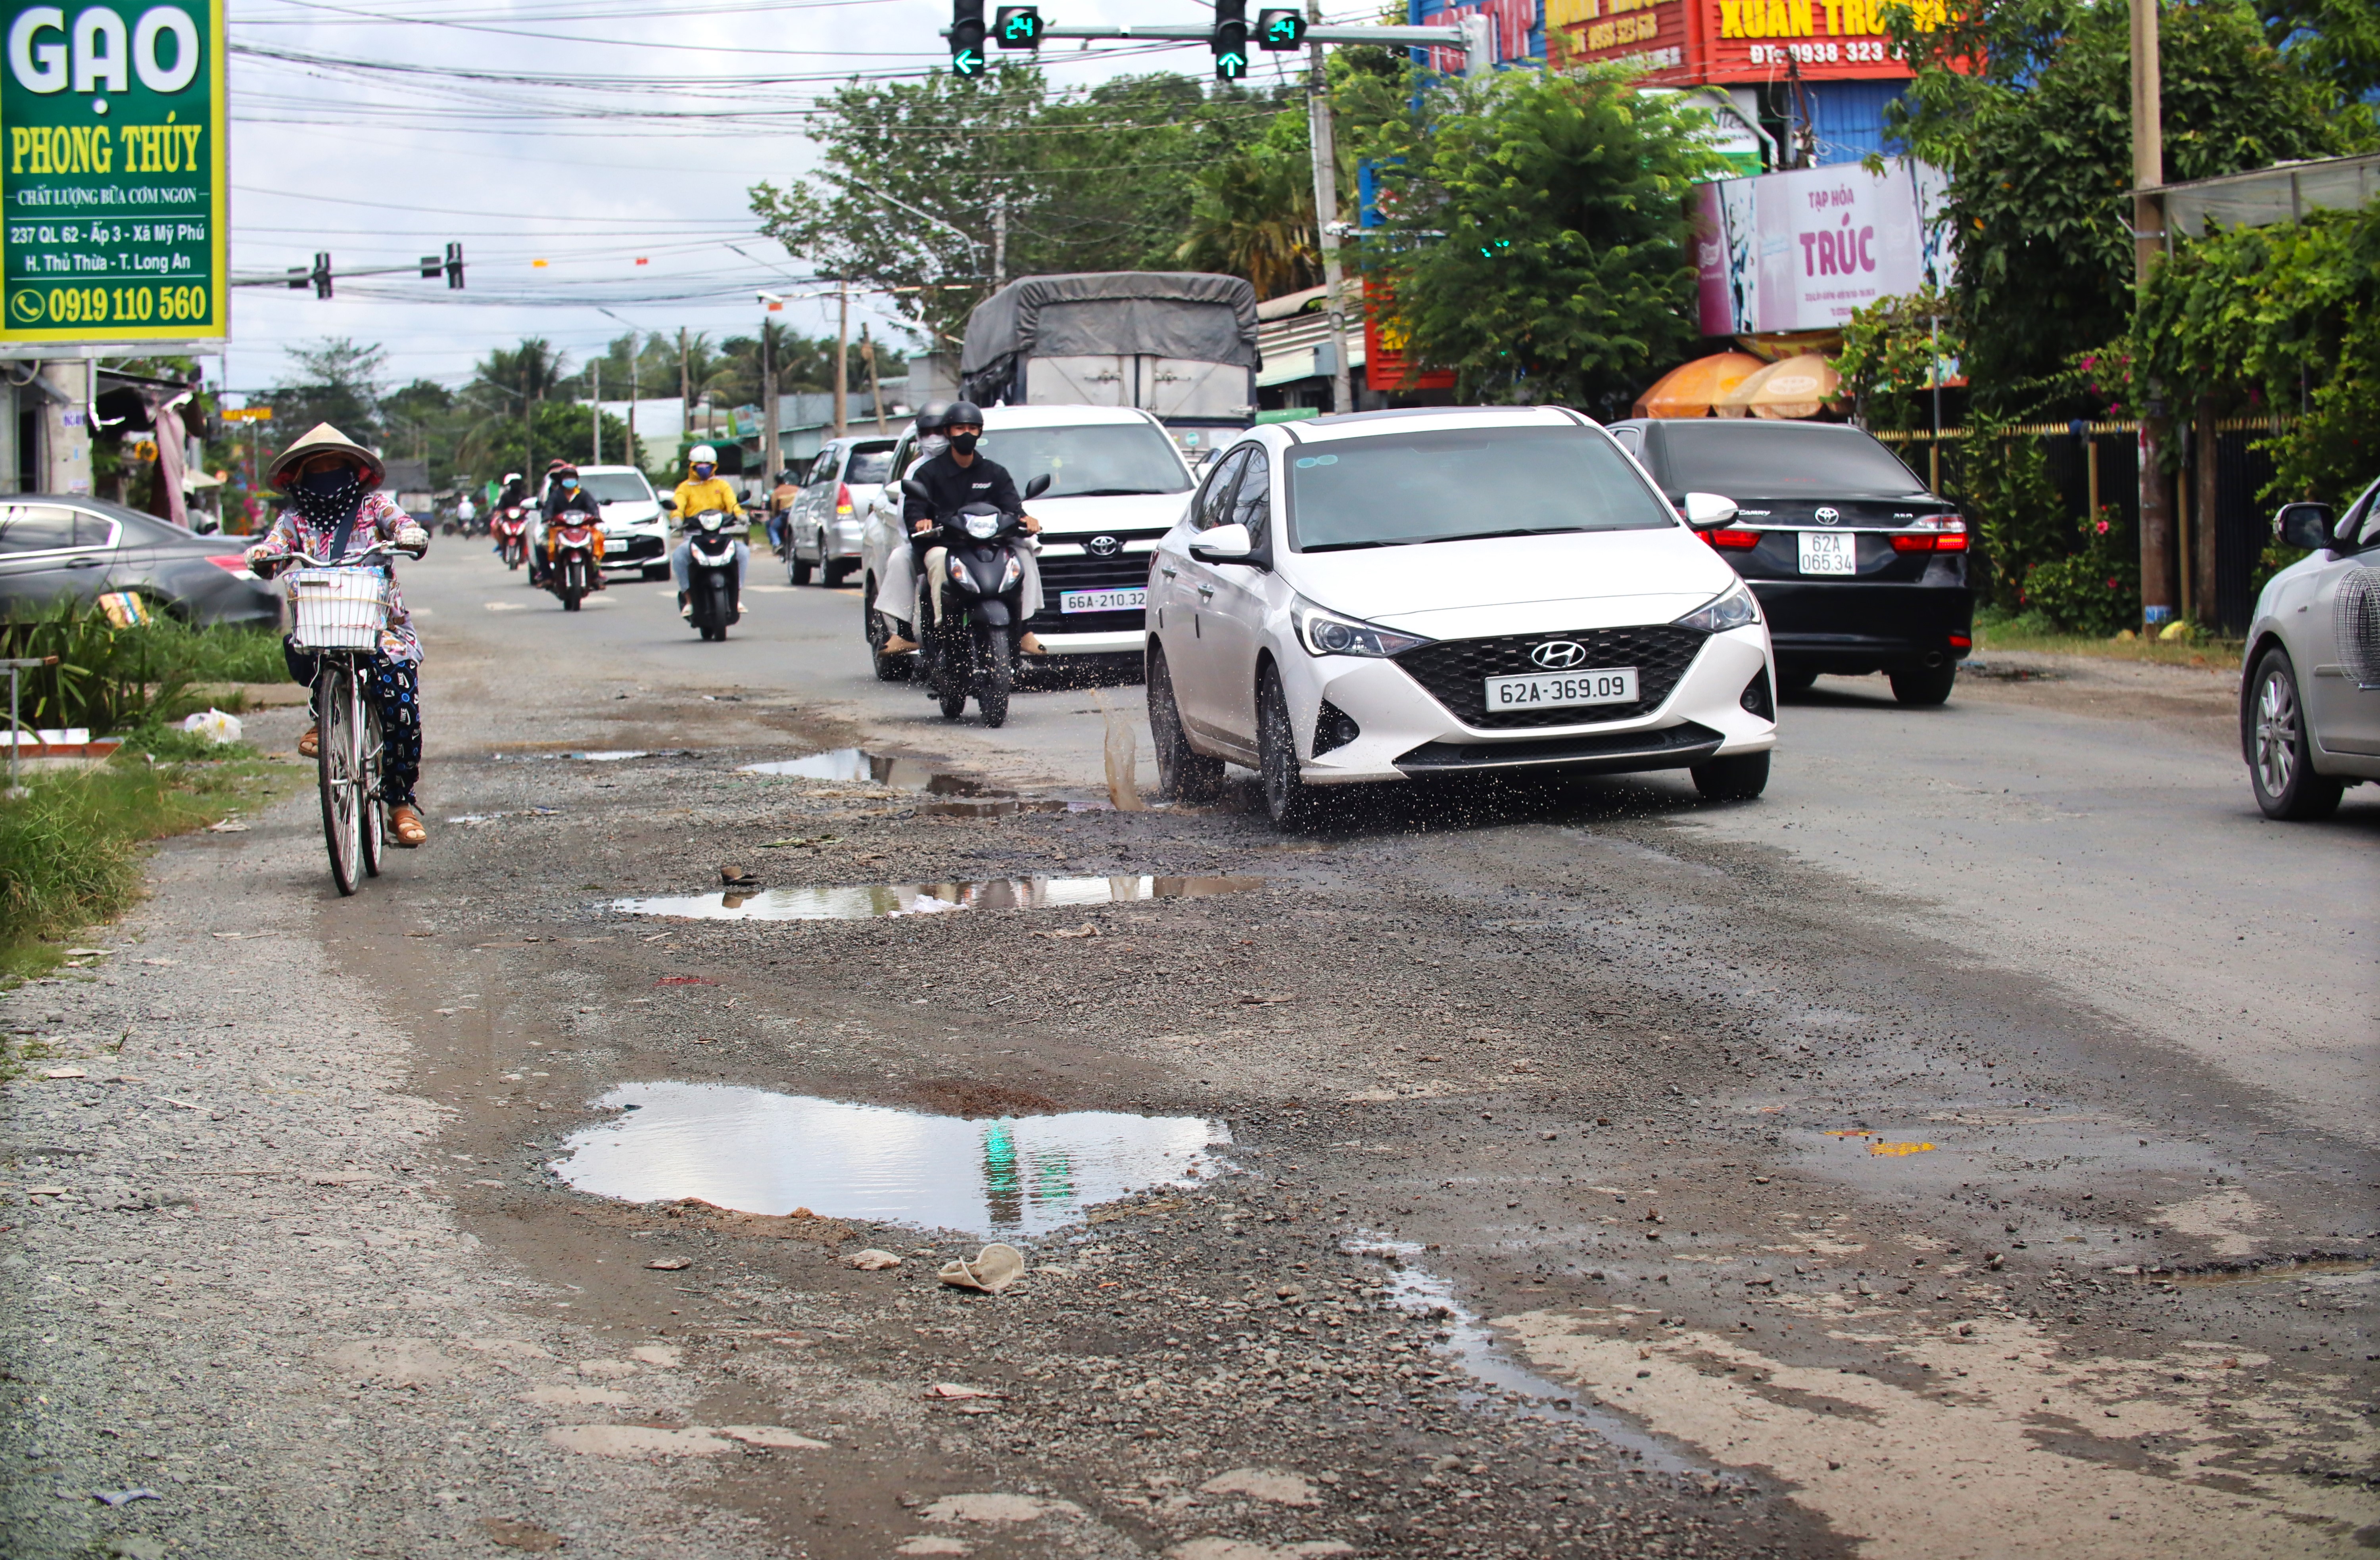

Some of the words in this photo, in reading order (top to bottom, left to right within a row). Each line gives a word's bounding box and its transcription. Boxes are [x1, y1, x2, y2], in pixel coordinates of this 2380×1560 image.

[1006, 16, 1033, 39] 24
[8, 5, 199, 114] GẠO
[1788, 42, 1838, 63] 0938
[1845, 41, 1884, 61] 323
[10, 125, 113, 174] PHONG
[120, 109, 202, 173] THÚY
[18, 184, 53, 206] CHẤT
[54, 187, 99, 209] LƯỢNG
[100, 184, 126, 205] BỮA
[128, 186, 159, 204] CƠM
[161, 187, 197, 203] NGON
[1808, 190, 1829, 213] TẠP
[1831, 183, 1854, 207] HÓA
[10, 227, 36, 244] 237
[39, 226, 60, 243] QL
[62, 226, 79, 243] 62
[90, 221, 110, 246] Ấp
[112, 225, 121, 242] 3
[132, 224, 151, 242] Xã
[154, 224, 174, 245] Mỹ
[177, 223, 205, 241] Phú
[1799, 211, 1876, 277] TRÚC
[25, 255, 41, 272] H.
[43, 252, 70, 271] Thủ
[73, 253, 107, 271] Thừa
[119, 253, 131, 270] T.
[134, 253, 169, 274] Long
[172, 252, 191, 269] An
[48, 288, 108, 322] 0919
[112, 286, 153, 320] 110
[159, 285, 206, 320] 560
[1813, 535, 1841, 553] 62A
[1802, 554, 1853, 571] 065.34
[1069, 593, 1145, 609] 66A-210.32
[1500, 676, 1624, 704] 62A-369.09
